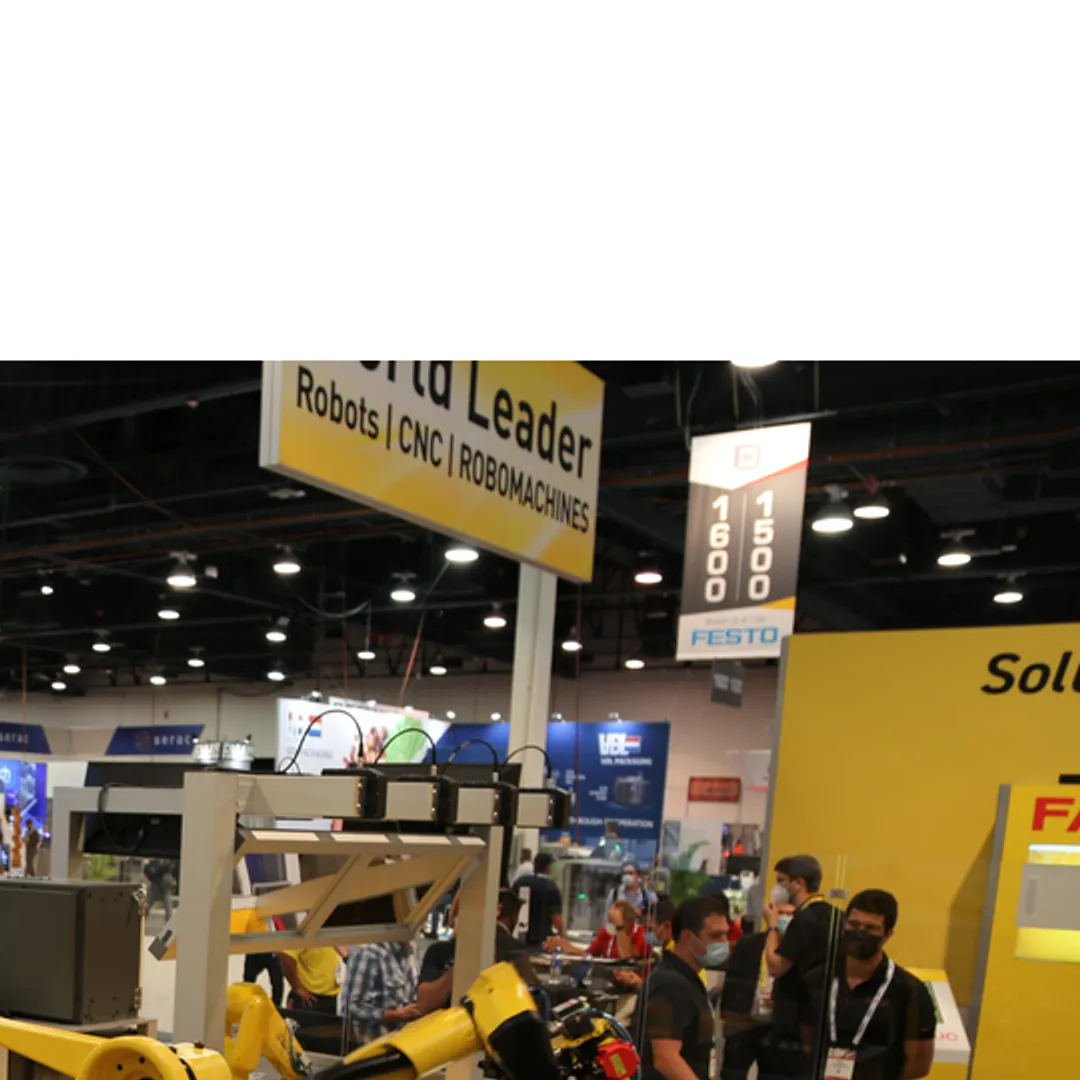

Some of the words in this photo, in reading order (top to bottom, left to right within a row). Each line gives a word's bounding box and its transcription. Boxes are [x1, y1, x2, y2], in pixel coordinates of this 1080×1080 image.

[296, 366, 380, 440] Robots
[398, 415, 443, 467] CNC
[459, 443, 591, 534] ROBOMACHINES
[468, 361, 592, 478] Leader
[705, 494, 731, 603] 1600
[748, 490, 774, 600] 1500
[691, 626, 779, 646] FESTO
[980, 651, 1080, 695] Sol
